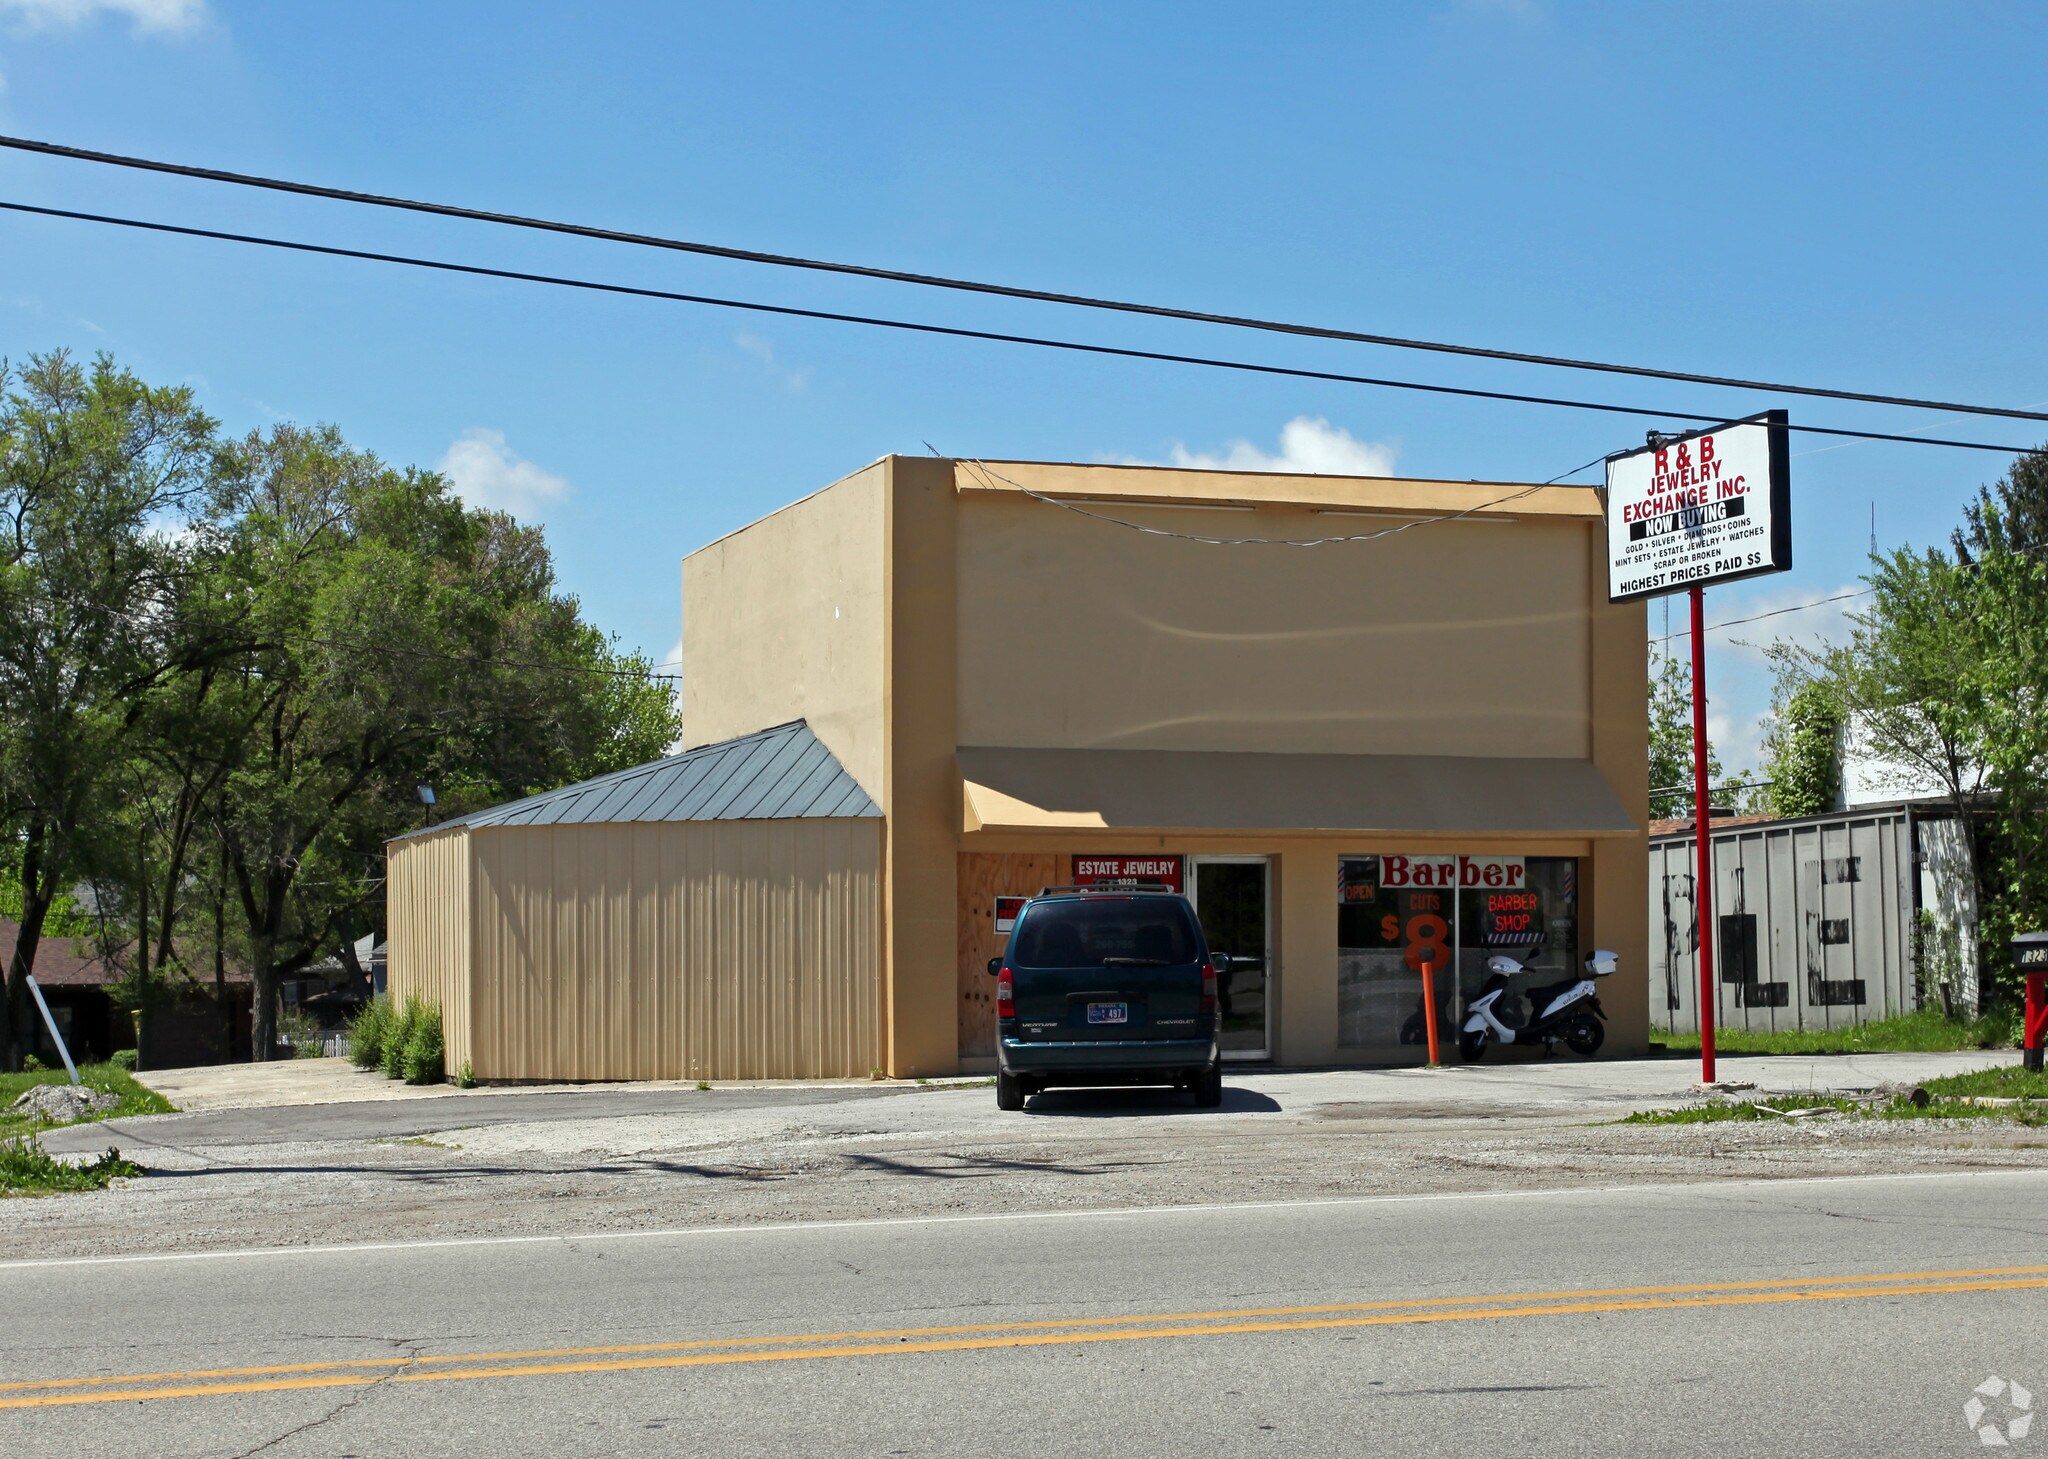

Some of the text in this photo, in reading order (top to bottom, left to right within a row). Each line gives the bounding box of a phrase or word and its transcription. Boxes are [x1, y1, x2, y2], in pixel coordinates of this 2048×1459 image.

[1655, 435, 1714, 476] R & B
[1647, 459, 1722, 497] JEWELRY
[1624, 475, 1750, 523] EXCHANGE INC.
[1625, 517, 1751, 554] GOLD SILVER DIAMONDS COINS
[1645, 502, 1727, 537] NOW BUYING
[1615, 526, 1764, 568] MINT SETS ESTATE JEWELRY WATCHES
[1653, 548, 1721, 570] SCRAP OR BROKEN
[1620, 573, 1666, 594] HIGHEST
[1670, 564, 1710, 583] PRICES
[1715, 556, 1742, 573] PAID
[1078, 861, 1175, 876] ESTATE JEWELRY
[1382, 855, 1523, 887] Barber
[1346, 885, 1374, 899] OPEN
[1410, 895, 1440, 910] CUTS
[1488, 893, 1537, 911] BARBER
[1495, 915, 1530, 931] SHOP
